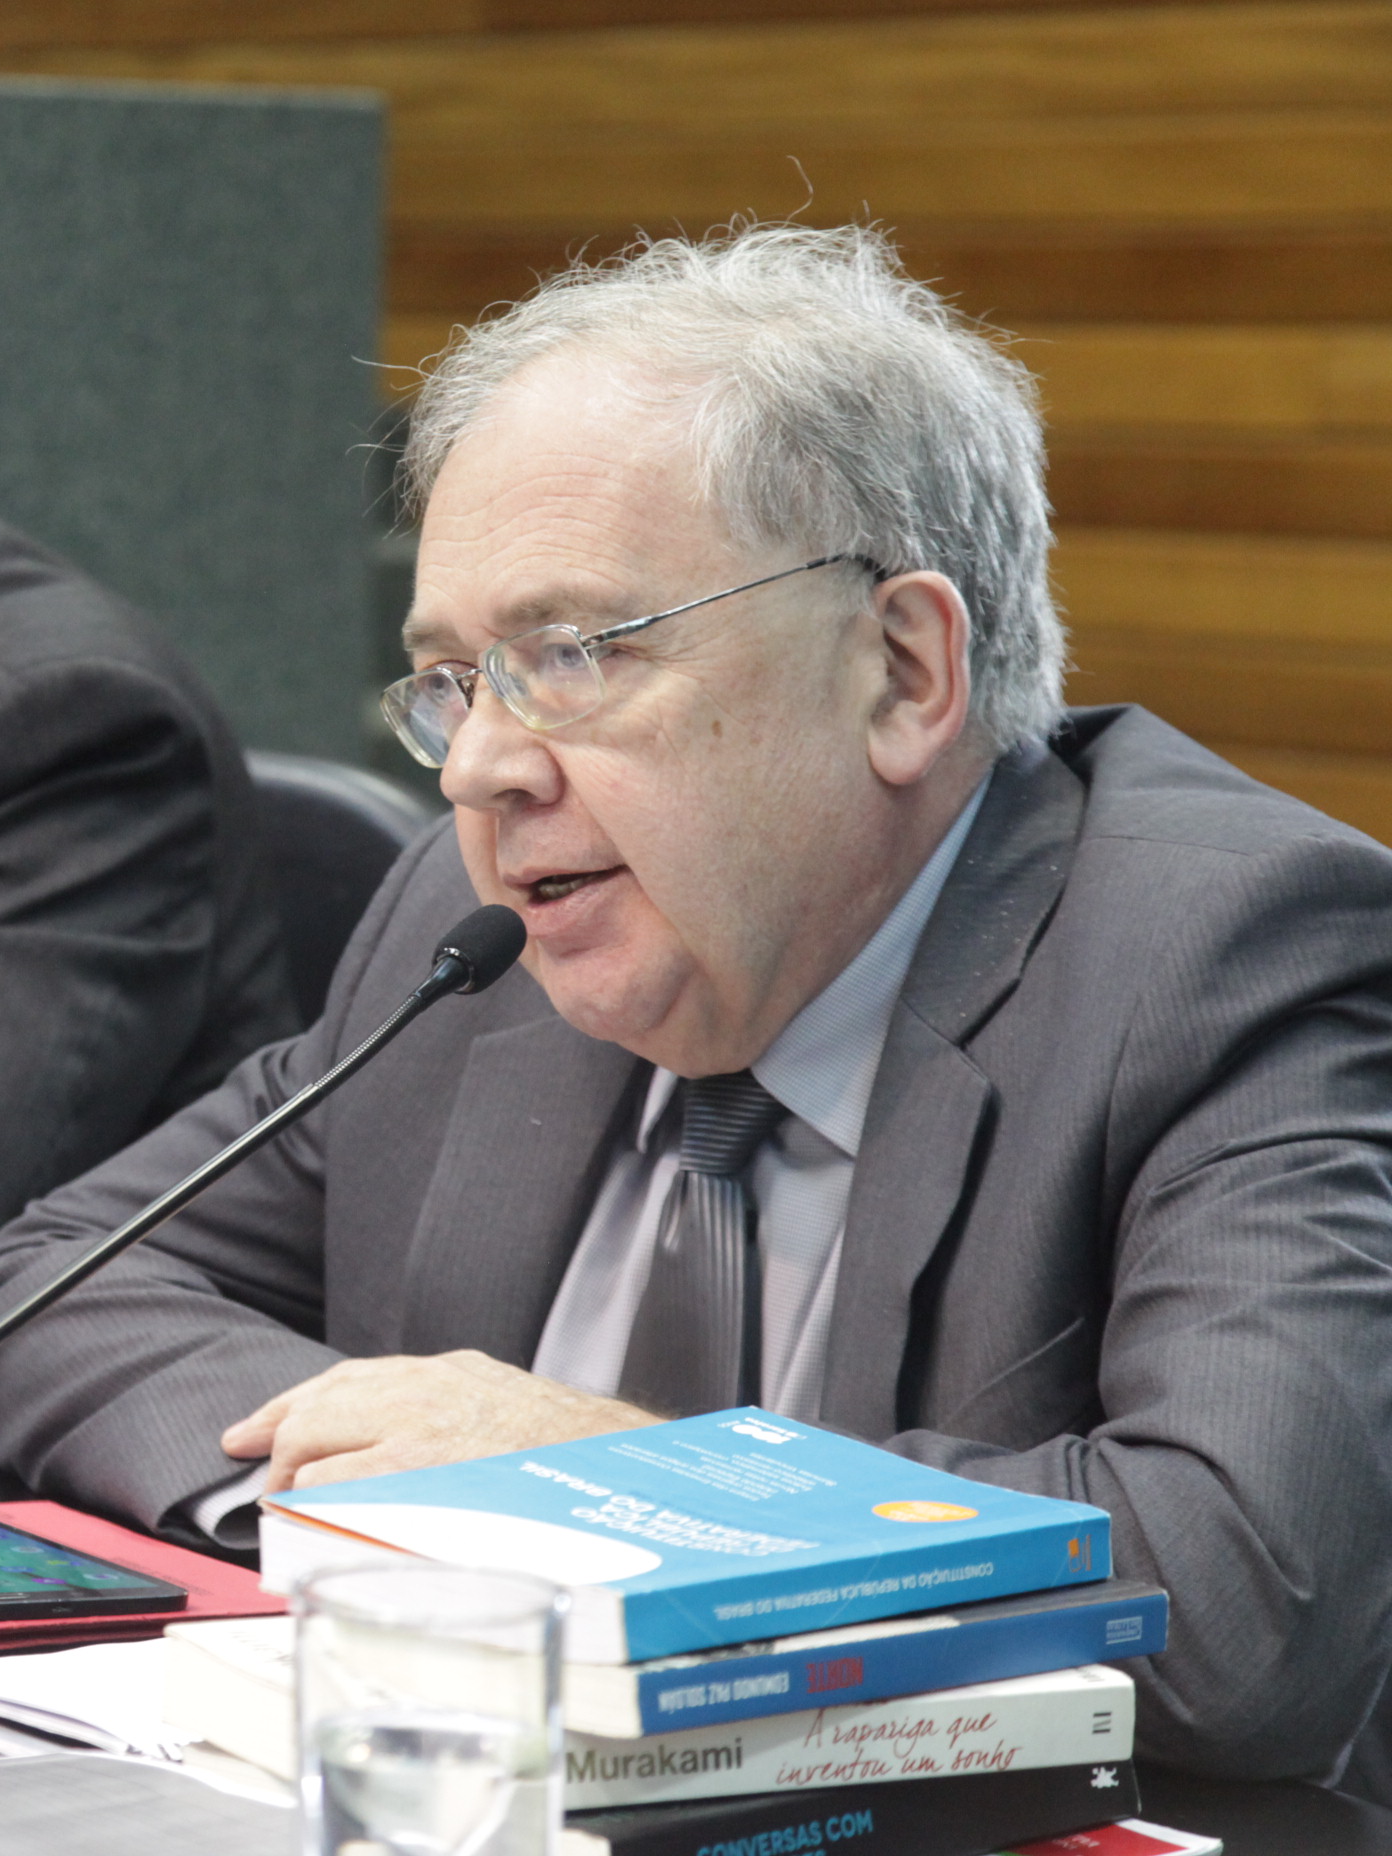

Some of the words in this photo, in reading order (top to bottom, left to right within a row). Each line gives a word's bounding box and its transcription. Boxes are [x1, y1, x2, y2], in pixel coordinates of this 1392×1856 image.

[519, 1461, 614, 1498] BRASIL
[839, 1578, 900, 1600] REPÚBLICA
[901, 1575, 917, 1590] DA
[918, 1562, 994, 1589] CONSTITUIÇÃO
[714, 1603, 754, 1621] BRASIL
[755, 1598, 773, 1615] DO
[775, 1588, 838, 1611] FEDERATIVA
[733, 1671, 790, 1701] EDMUNDO
[806, 1656, 864, 1694] NORTE
[708, 1682, 731, 1705] PAZ
[803, 1707, 829, 1748] A
[830, 1712, 941, 1758] rapariga
[946, 1710, 998, 1745] que
[565, 1737, 743, 1784] Murakami
[775, 1747, 896, 1786] inventou
[898, 1754, 944, 1775] um
[950, 1738, 1023, 1771] sonho
[825, 1808, 875, 1842] COM
